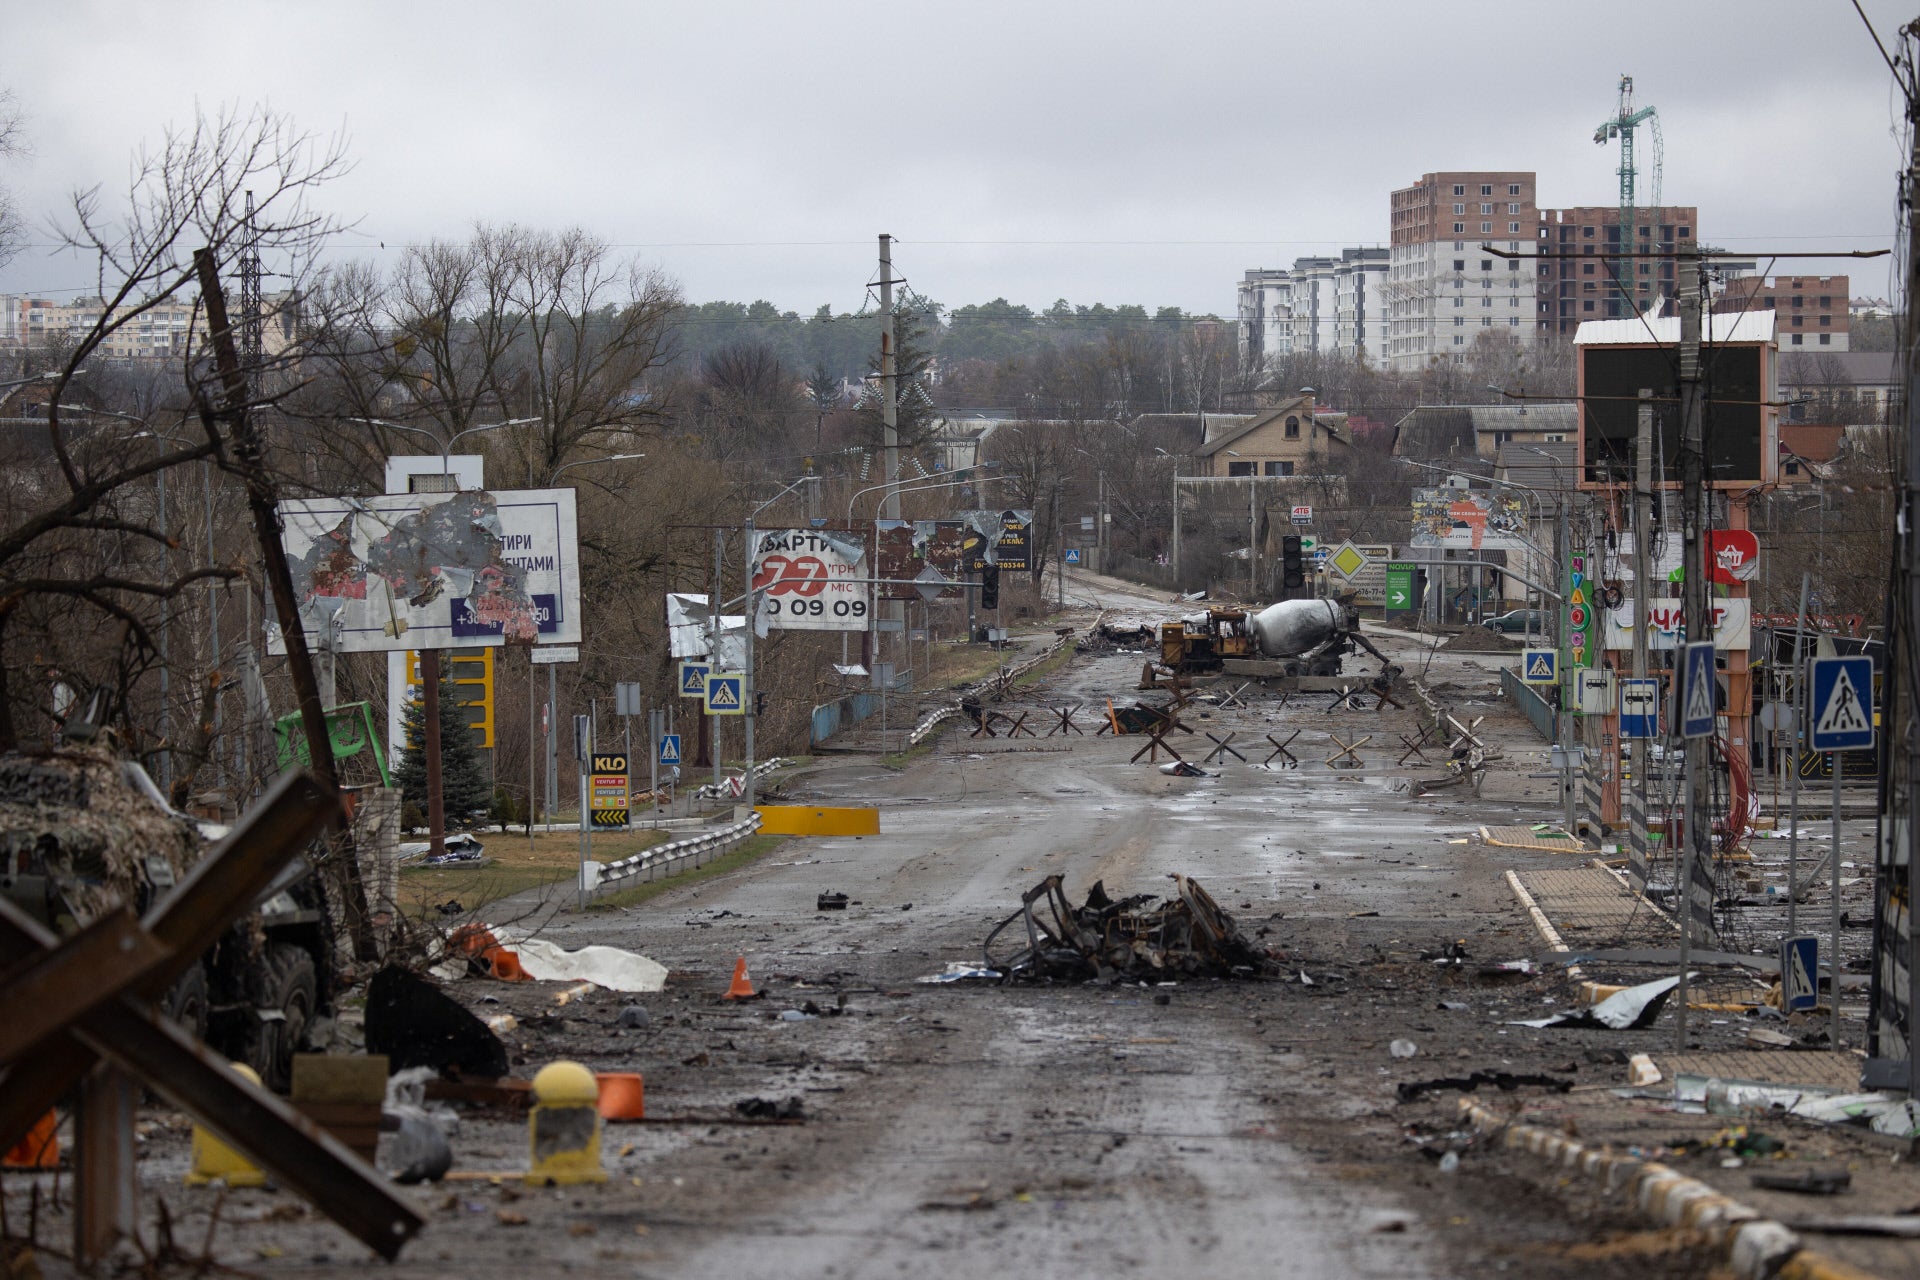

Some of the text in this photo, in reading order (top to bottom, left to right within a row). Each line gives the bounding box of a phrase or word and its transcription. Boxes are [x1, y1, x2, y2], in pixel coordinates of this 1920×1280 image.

[498, 535, 532, 551] ТИРИ
[790, 599, 824, 616] 09
[833, 600, 867, 617] 09
[594, 757, 626, 771] KLO
